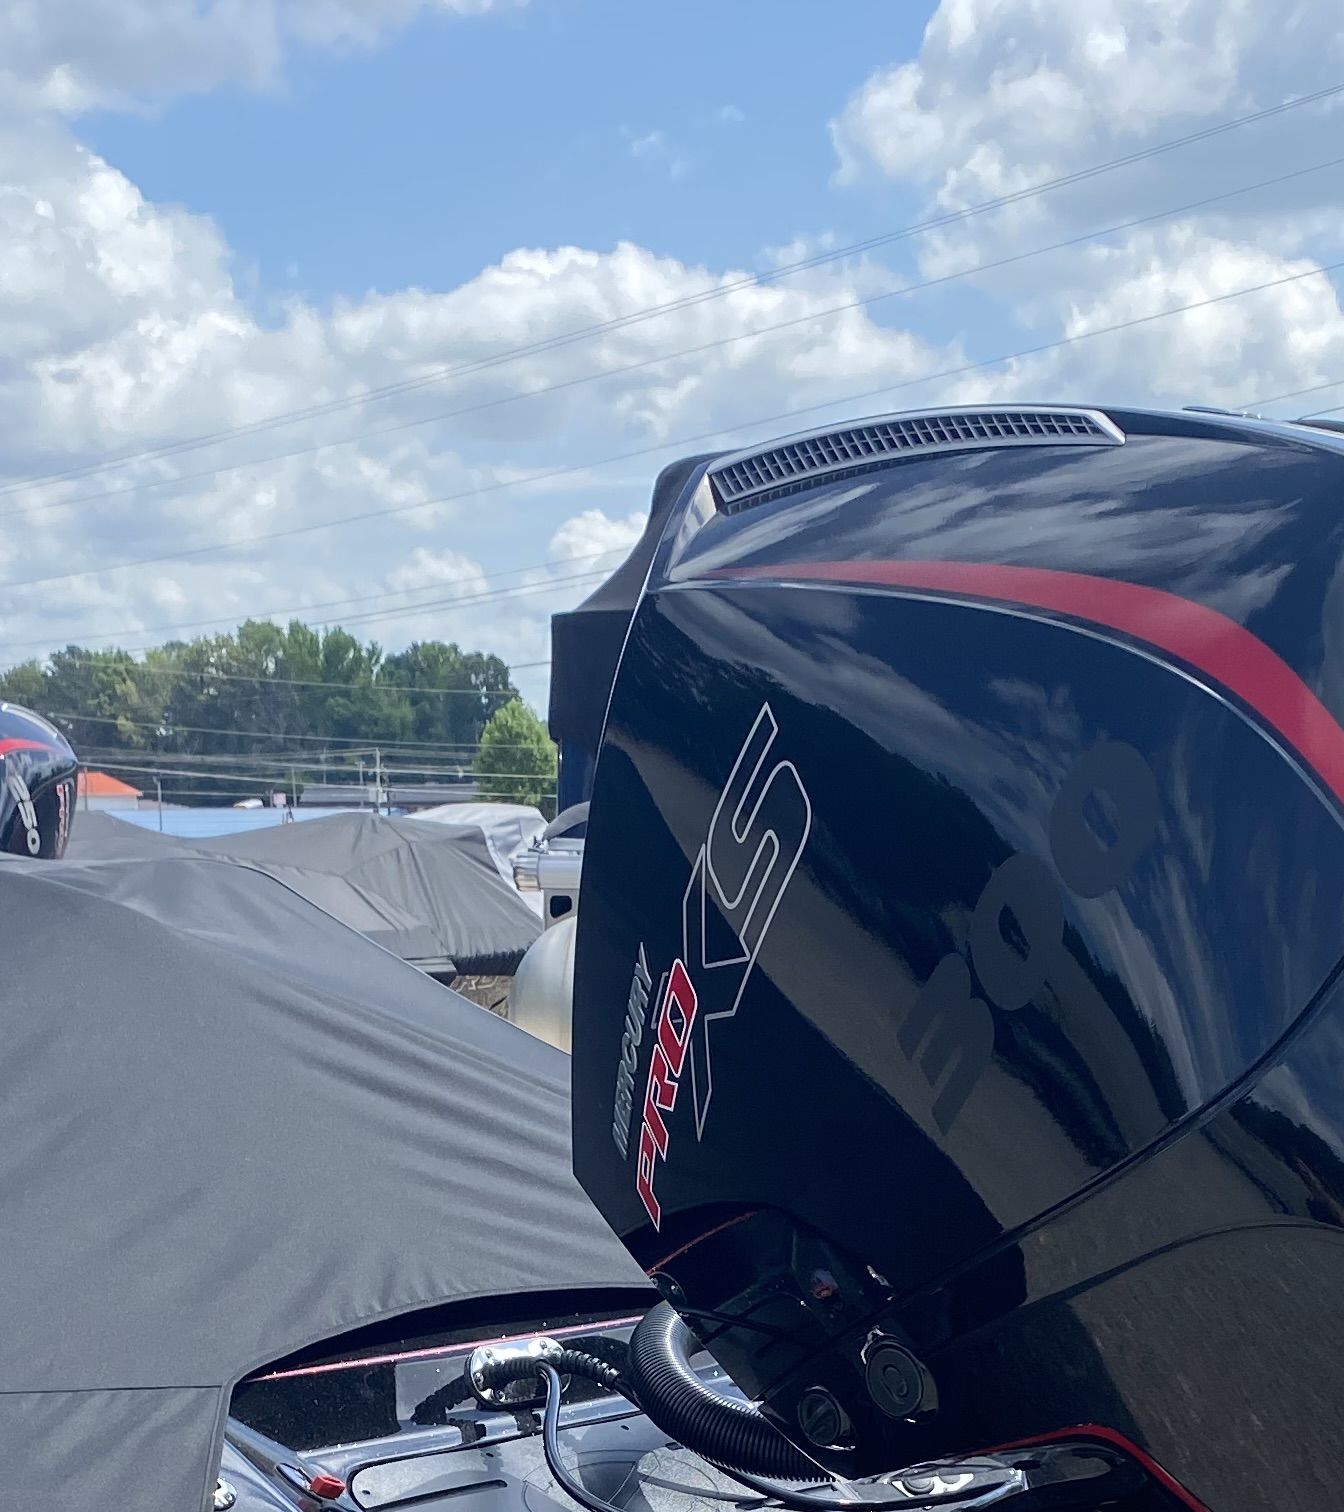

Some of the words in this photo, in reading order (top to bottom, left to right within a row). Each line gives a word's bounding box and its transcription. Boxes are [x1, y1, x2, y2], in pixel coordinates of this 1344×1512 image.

[5, 771, 41, 855] 250
[652, 702, 812, 1141] XS
[896, 740, 1157, 1137] 300
[612, 941, 653, 1161] MERCURY
[636, 958, 698, 1233] PRO
